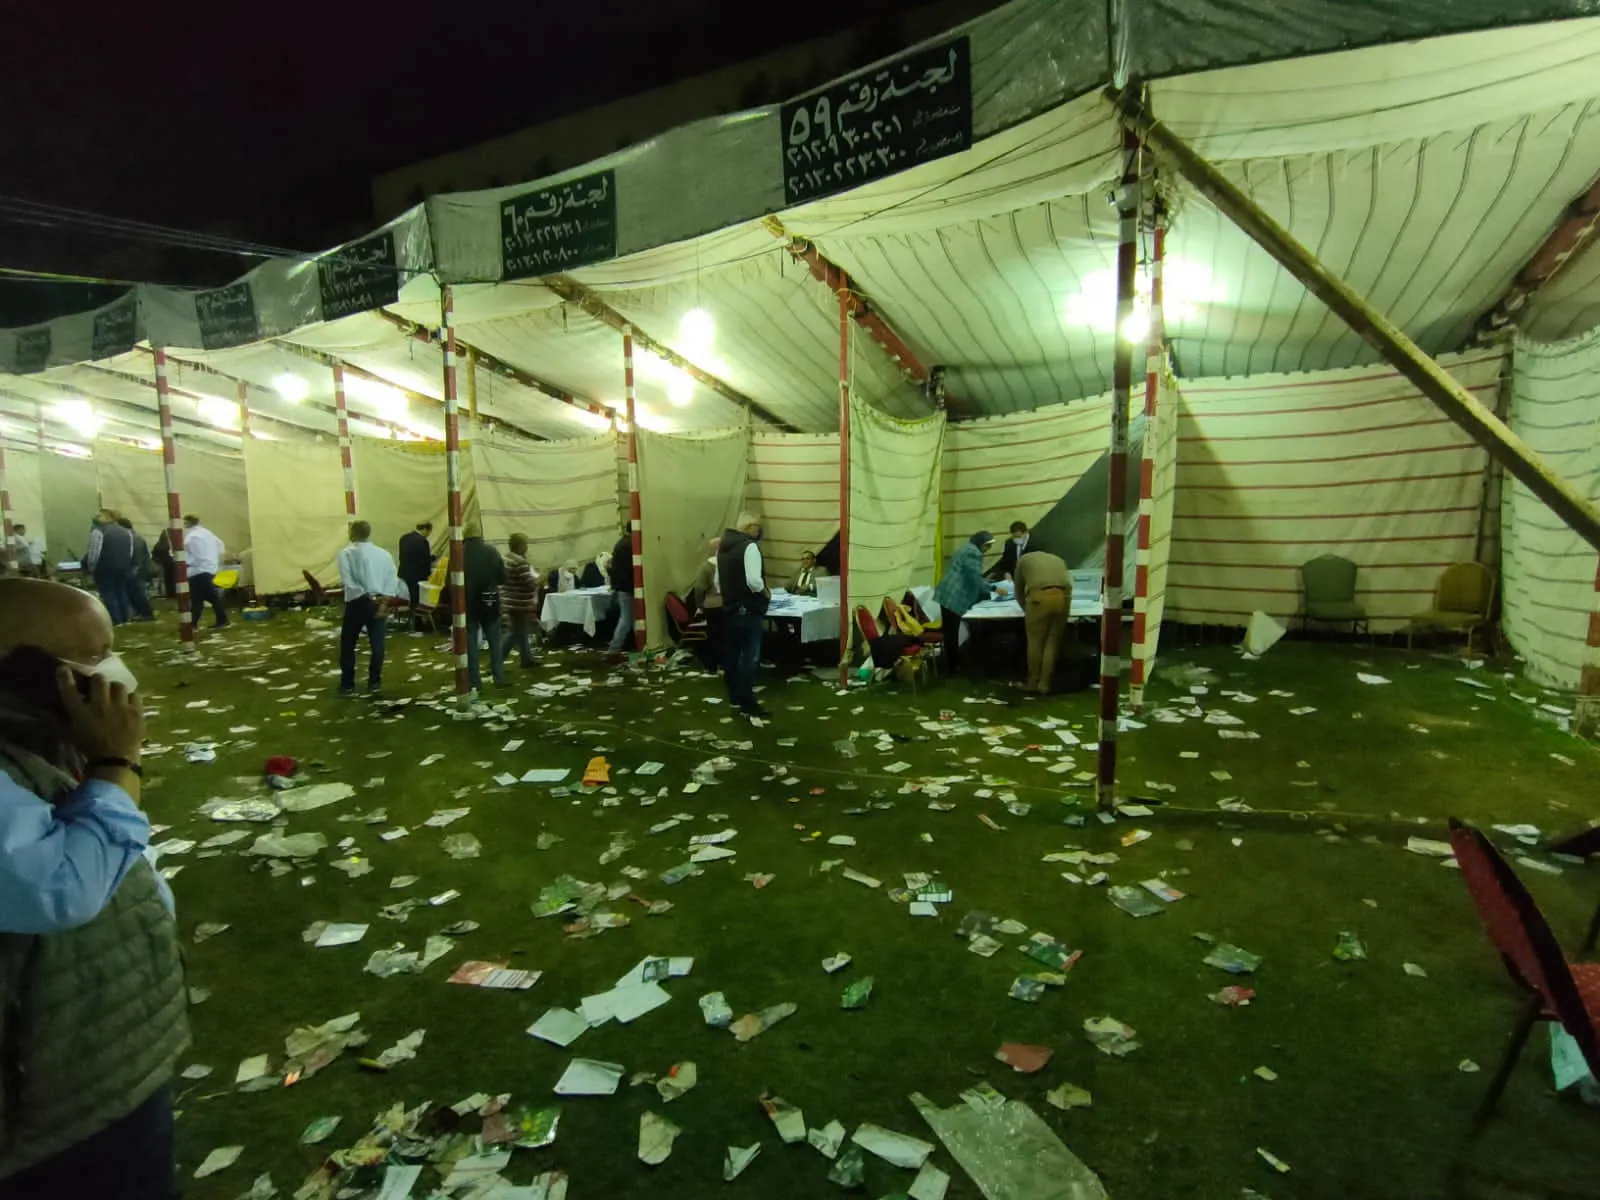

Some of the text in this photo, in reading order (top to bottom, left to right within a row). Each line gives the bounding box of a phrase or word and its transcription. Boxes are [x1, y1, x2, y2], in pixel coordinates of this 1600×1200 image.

[876, 48, 957, 101] لجنة
[788, 96, 832, 145] ٥٩
[837, 82, 878, 133] رقم
[525, 192, 563, 232] رقم
[564, 175, 608, 208] لجنة
[504, 205, 524, 235] ٦٠
